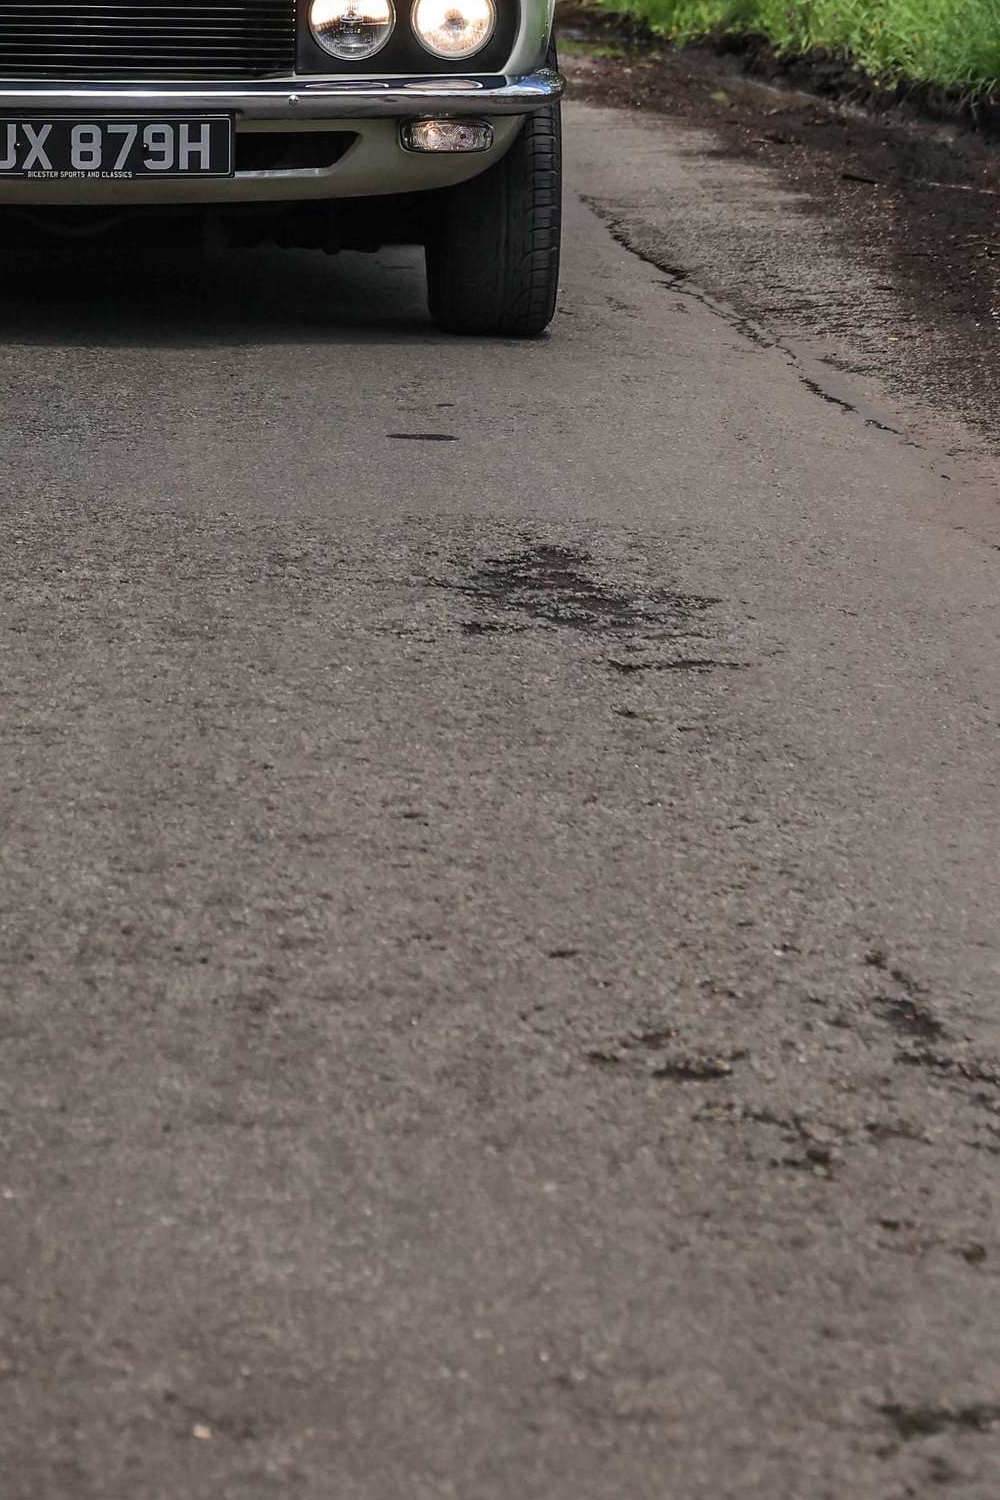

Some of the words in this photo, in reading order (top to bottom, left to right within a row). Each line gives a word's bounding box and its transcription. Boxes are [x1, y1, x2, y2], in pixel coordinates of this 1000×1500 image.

[71, 123, 211, 170] 879H
[27, 171, 59, 179] BICESTER
[60, 171, 85, 179] SPORTS
[87, 171, 100, 179] AND
[101, 171, 133, 179] CLASSICS
